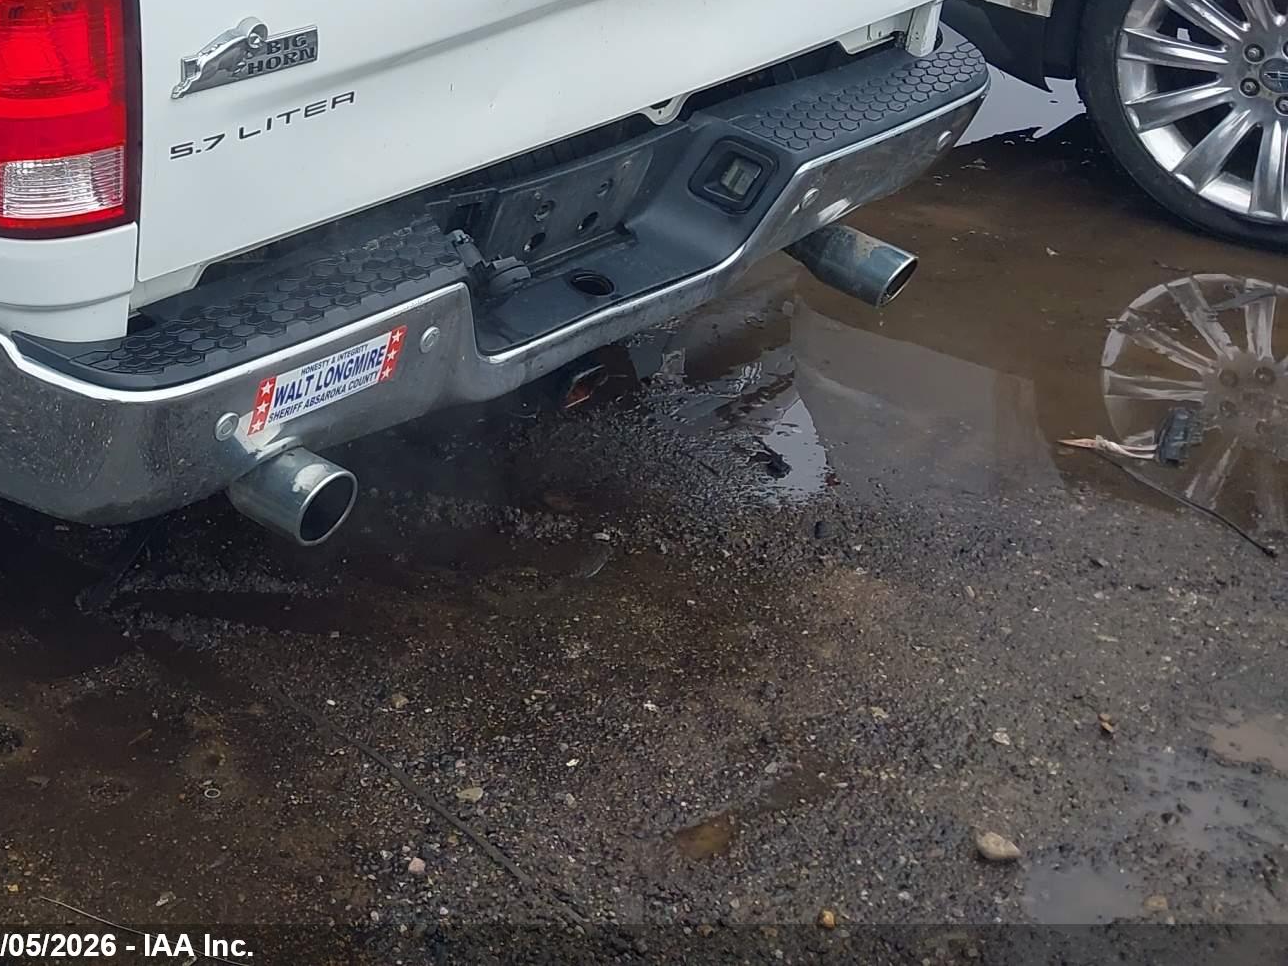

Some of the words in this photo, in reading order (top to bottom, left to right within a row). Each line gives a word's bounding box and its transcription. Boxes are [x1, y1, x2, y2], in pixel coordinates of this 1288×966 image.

[247, 46, 315, 75] HORN
[265, 33, 308, 55] BIG
[170, 133, 225, 160] 5.7
[238, 91, 355, 139] LITER
[273, 374, 315, 409] WALT
[315, 345, 387, 392] LONGMIRE
[301, 359, 330, 375] HONESTY
[268, 401, 304, 423] SHERIFF
[303, 385, 347, 409] ABSAROKA
[347, 371, 379, 391] COUNTY
